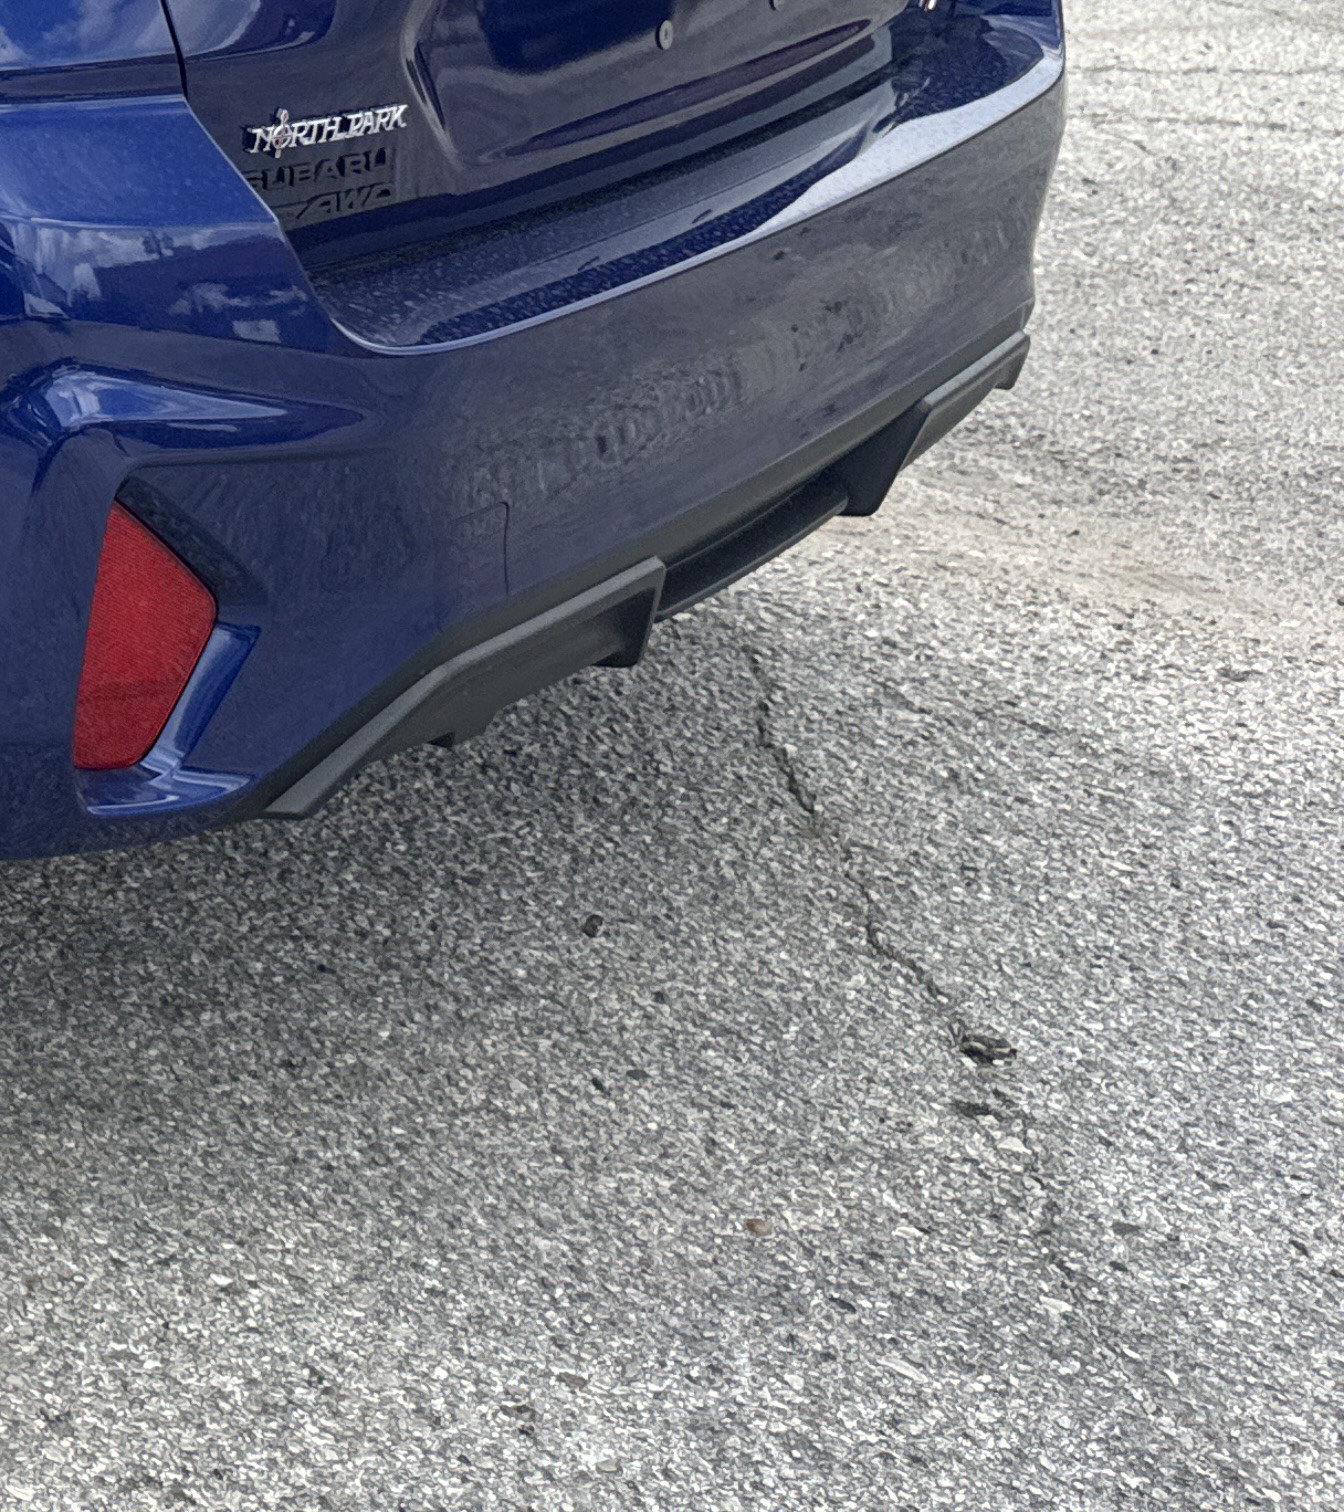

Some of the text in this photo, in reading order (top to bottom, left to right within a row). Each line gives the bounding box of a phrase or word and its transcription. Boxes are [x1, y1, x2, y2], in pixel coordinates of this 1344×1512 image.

[244, 104, 409, 158] NORTH PARK
[243, 147, 394, 190] SUBARU
